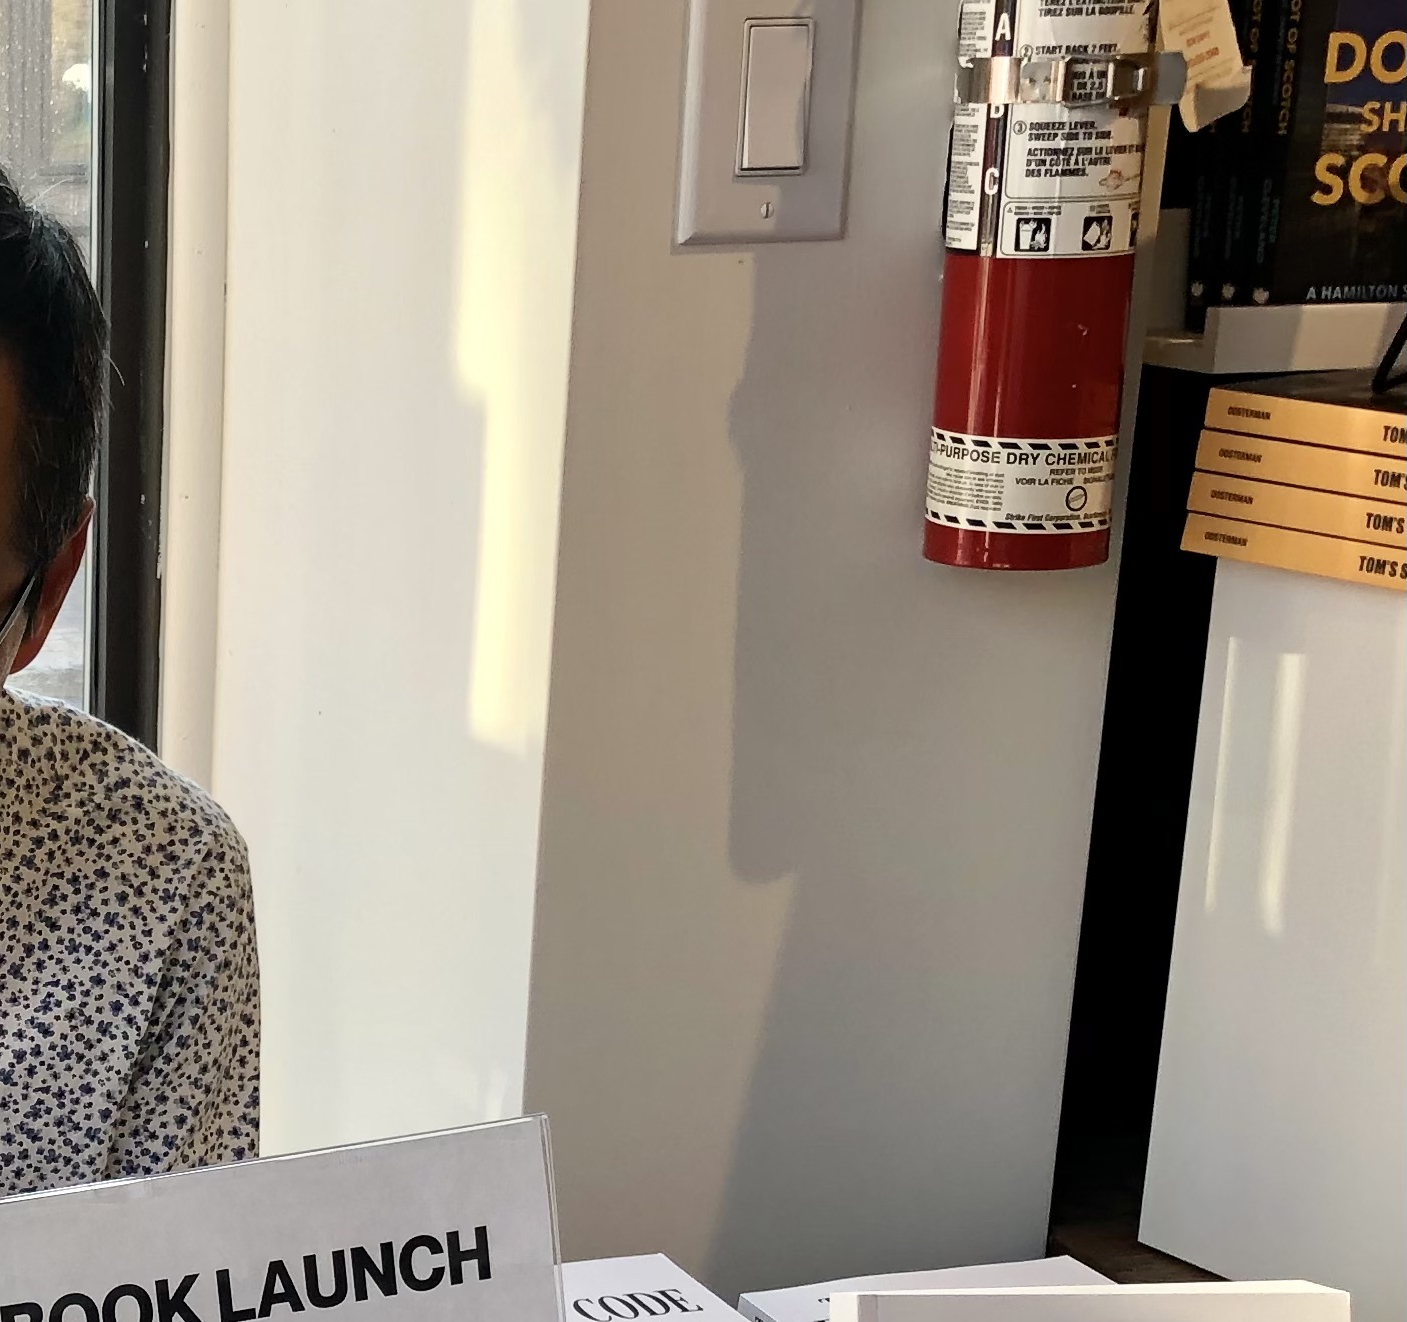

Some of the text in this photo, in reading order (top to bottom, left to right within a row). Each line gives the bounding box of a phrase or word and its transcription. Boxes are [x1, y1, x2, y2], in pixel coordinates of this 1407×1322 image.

[994, 13, 1011, 41] A
[1287, 27, 1299, 53] OF
[1035, 45, 1063, 55] START
[1277, 60, 1295, 135] SCOTCH
[1029, 121, 1066, 131] SQUEEZE
[1028, 132, 1058, 142] SWEEP
[984, 167, 999, 195] C
[1025, 168, 1042, 178] DES
[1306, 286, 1317, 299] A
[1321, 284, 1399, 299] HAMILTON
[1006, 452, 1041, 466] DRY
[1045, 450, 1110, 466] CHEMICAL
[1366, 512, 1405, 534] TOM'S
[1358, 555, 1398, 578] TOM'S
